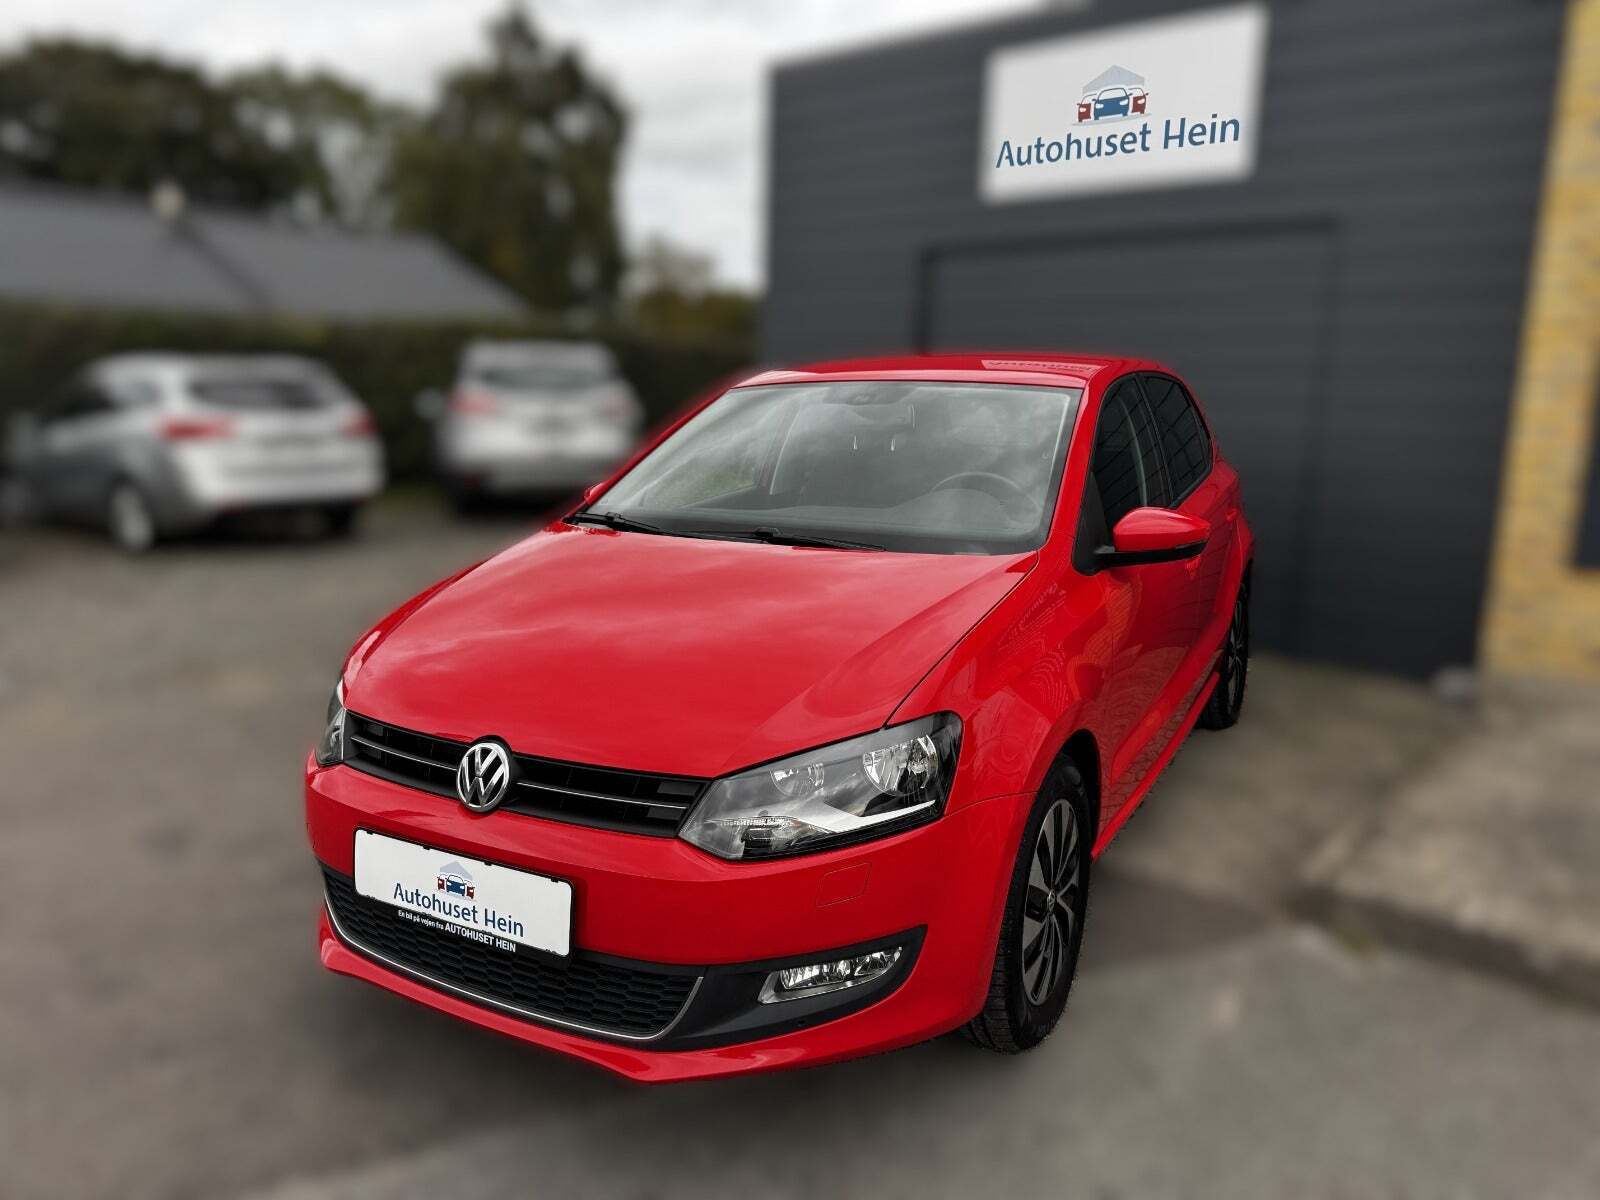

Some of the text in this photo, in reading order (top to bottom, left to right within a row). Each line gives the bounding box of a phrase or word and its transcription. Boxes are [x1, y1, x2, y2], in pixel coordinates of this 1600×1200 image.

[996, 113, 1240, 168] Autohuset Hein
[393, 883, 524, 937] Autohuset Hein
[405, 911, 413, 920] bil
[413, 914, 420, 923] på
[420, 917, 436, 928] vejen
[436, 921, 444, 930] fra
[445, 922, 494, 946] AUTOHUSET
[495, 939, 516, 953] HEIN
